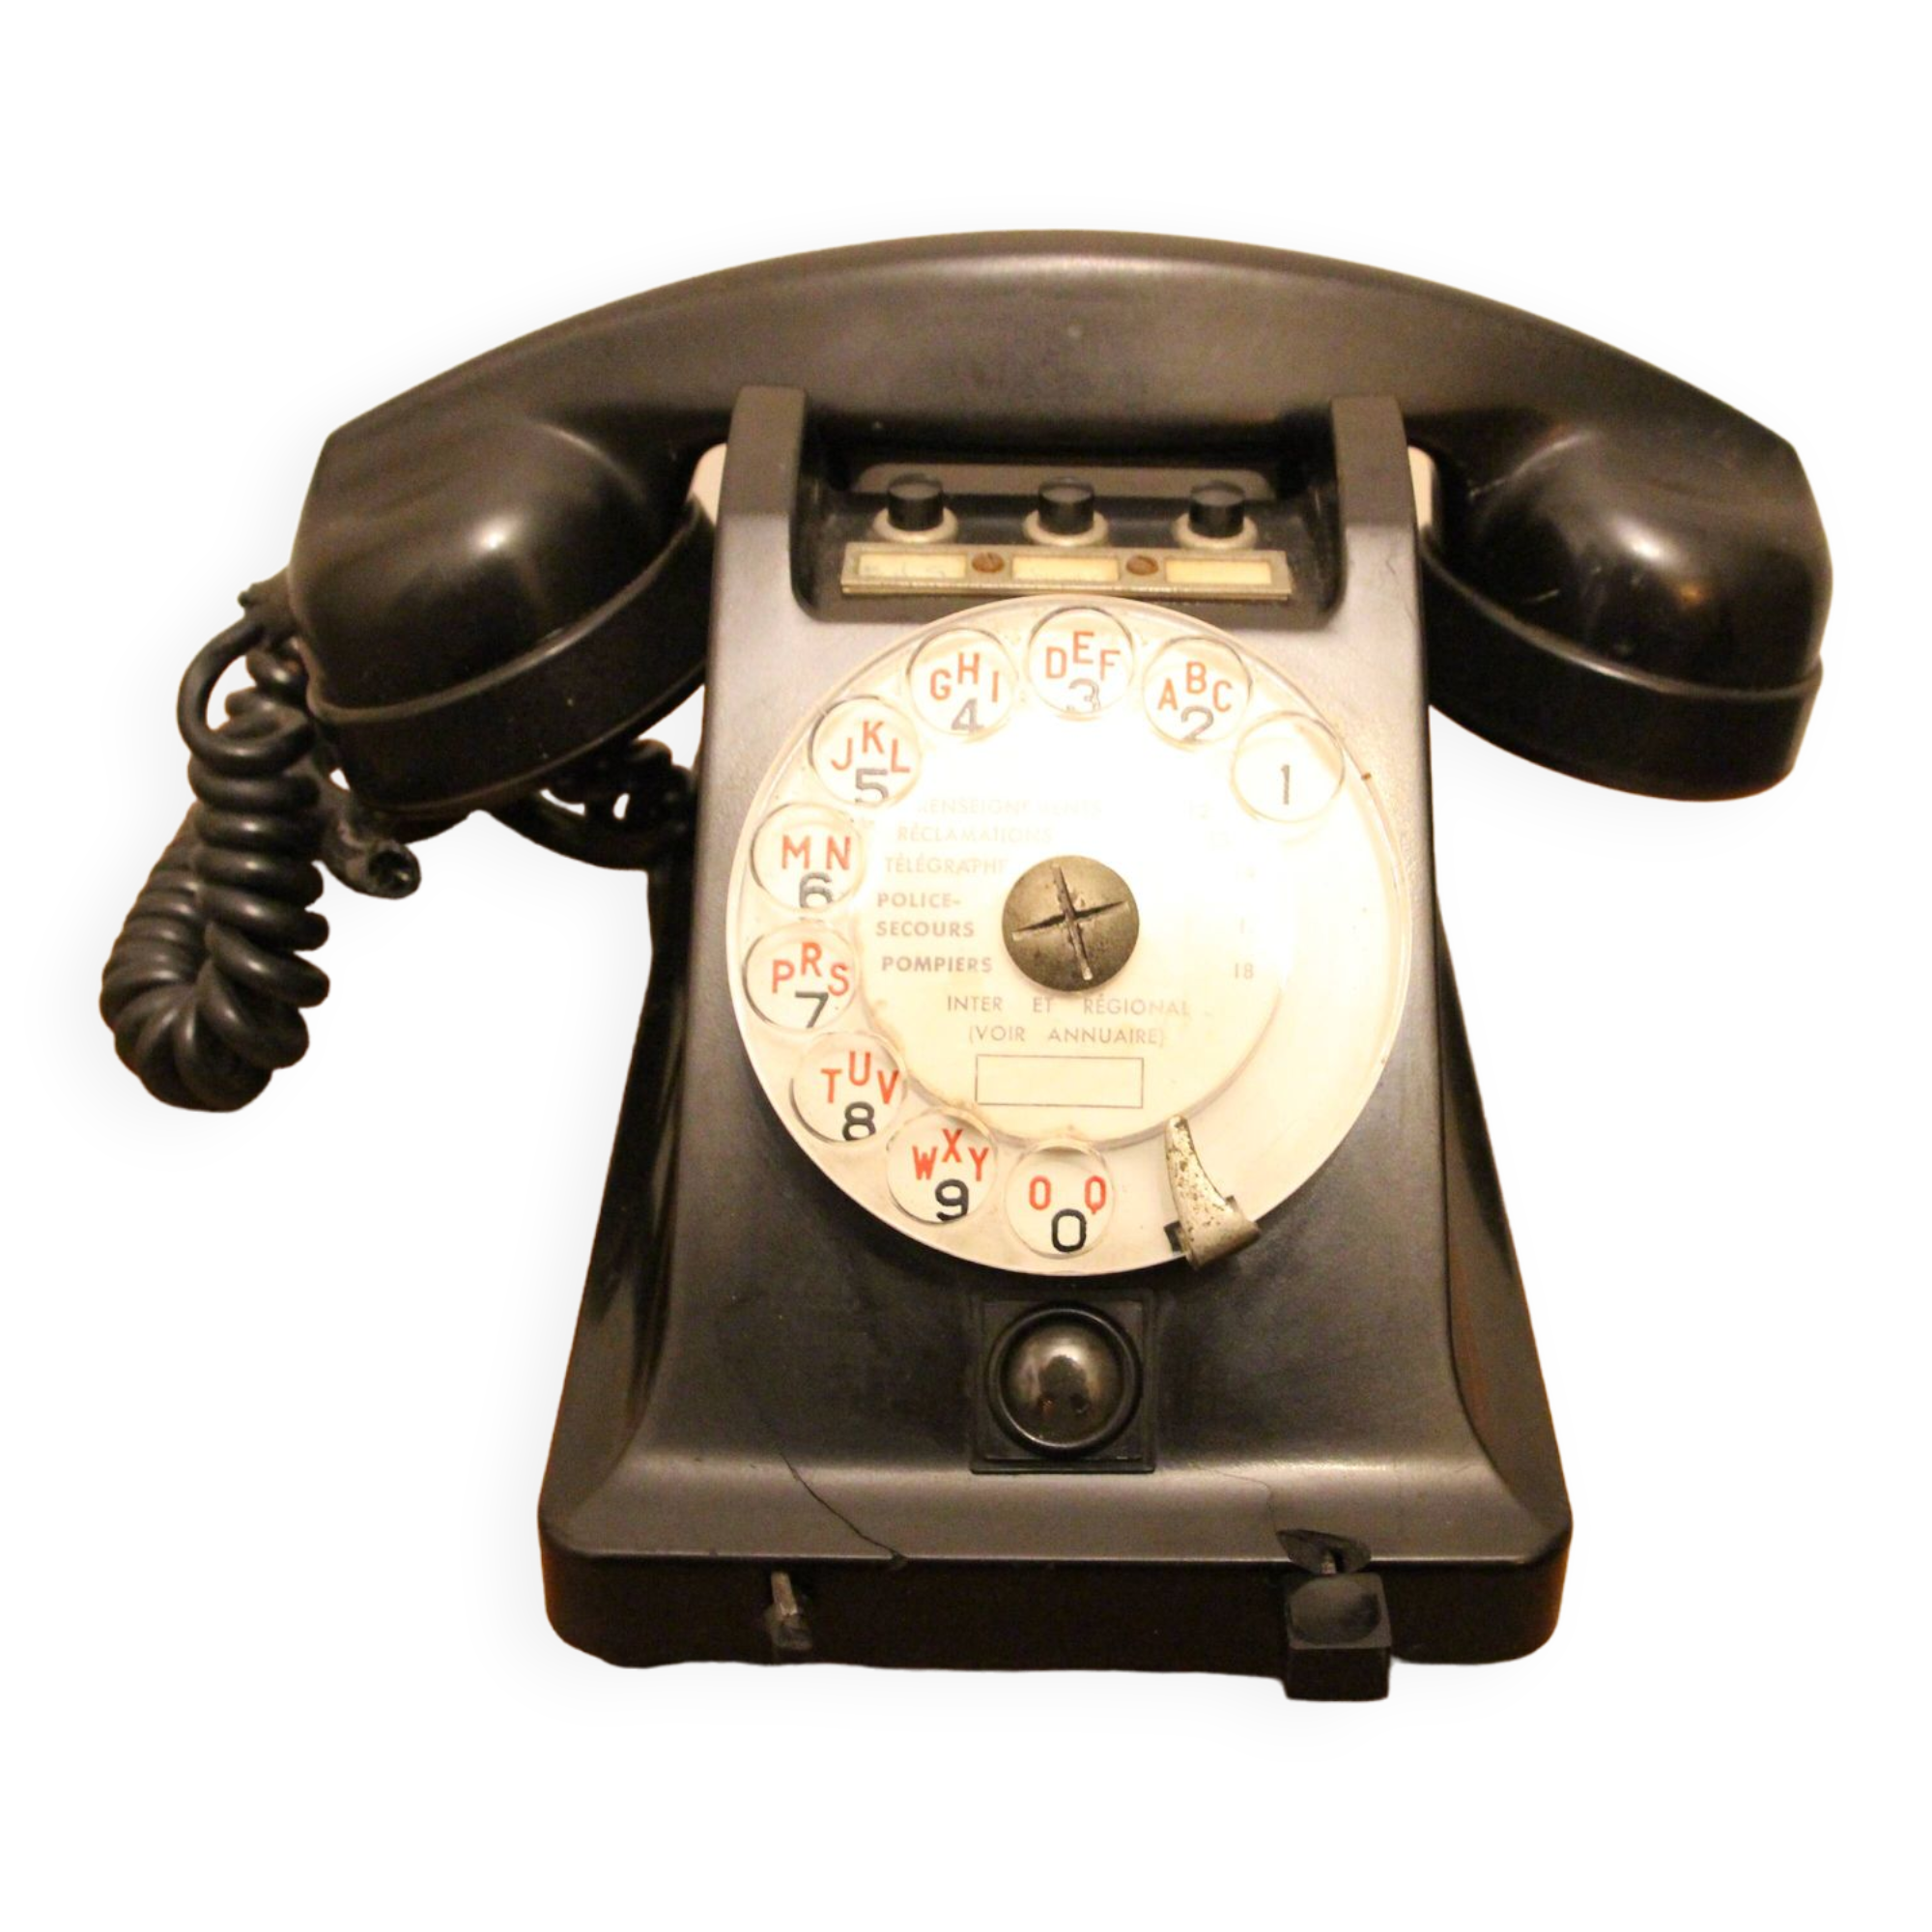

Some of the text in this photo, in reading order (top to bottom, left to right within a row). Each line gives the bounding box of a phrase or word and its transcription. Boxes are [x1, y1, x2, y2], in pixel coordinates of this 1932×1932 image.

[1046, 631, 1121, 681] DEF
[930, 652, 999, 702] GHI
[1068, 679, 1100, 712] 3
[1158, 662, 1233, 711] ABC
[952, 698, 981, 731] 4
[1180, 706, 1213, 743] 2
[832, 721, 910, 774] JKL
[855, 768, 890, 803] 5
[1281, 765, 1290, 805] 1
[799, 872, 834, 909] 6
[877, 893, 962, 908] POLICE-
[875, 922, 975, 937] SECOURS
[773, 943, 849, 996] PRS
[881, 956, 992, 972] POMPIERS
[1234, 962, 1254, 980] 18
[795, 992, 829, 1029] 7
[947, 994, 1192, 1015] INTER ET RÉGIONAL
[968, 1026, 1025, 1044] (VOIR
[821, 1052, 899, 1104] TUV
[842, 1101, 876, 1142] 8
[913, 1128, 988, 1181] WXY
[936, 1179, 970, 1221] 9
